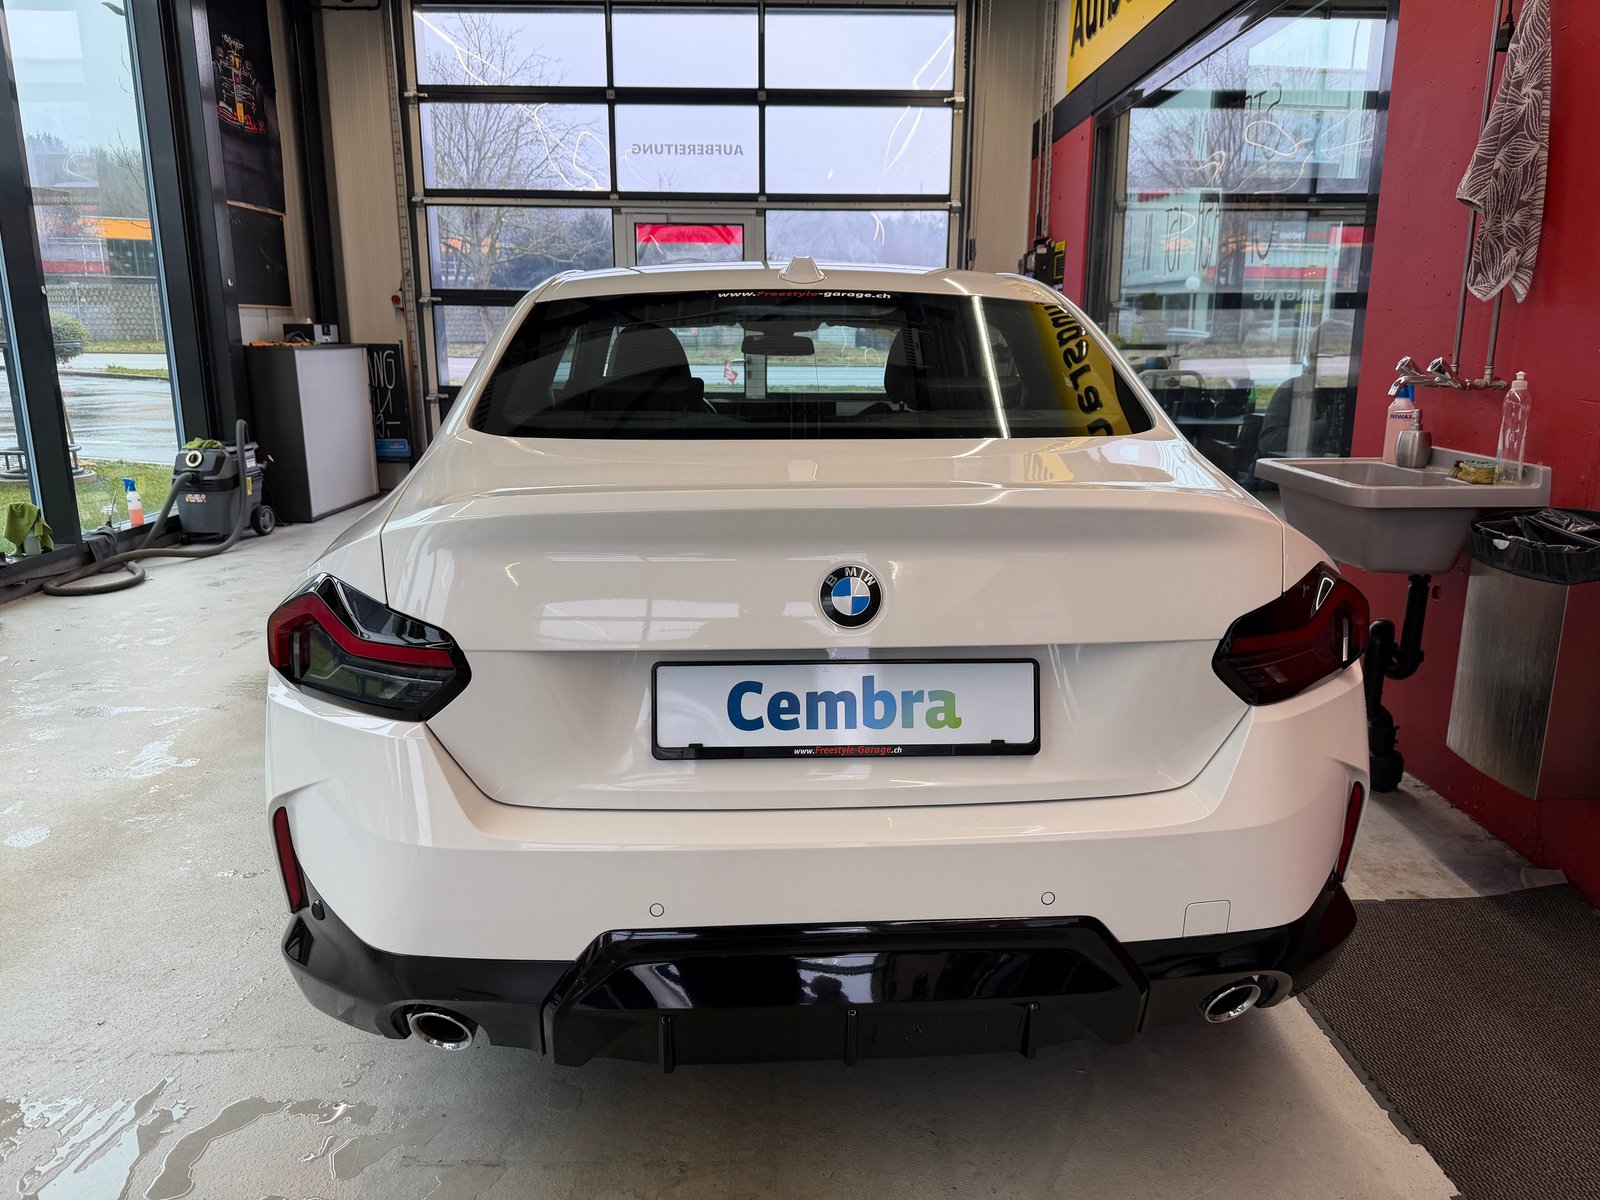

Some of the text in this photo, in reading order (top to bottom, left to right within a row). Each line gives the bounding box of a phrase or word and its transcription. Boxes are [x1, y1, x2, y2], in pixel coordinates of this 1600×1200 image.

[717, 290, 892, 299] www.Freestyle-garage.ch
[825, 567, 877, 588] BMW
[727, 675, 962, 732] Cembra
[793, 745, 903, 756] www.Freestyle-Garage.ch
